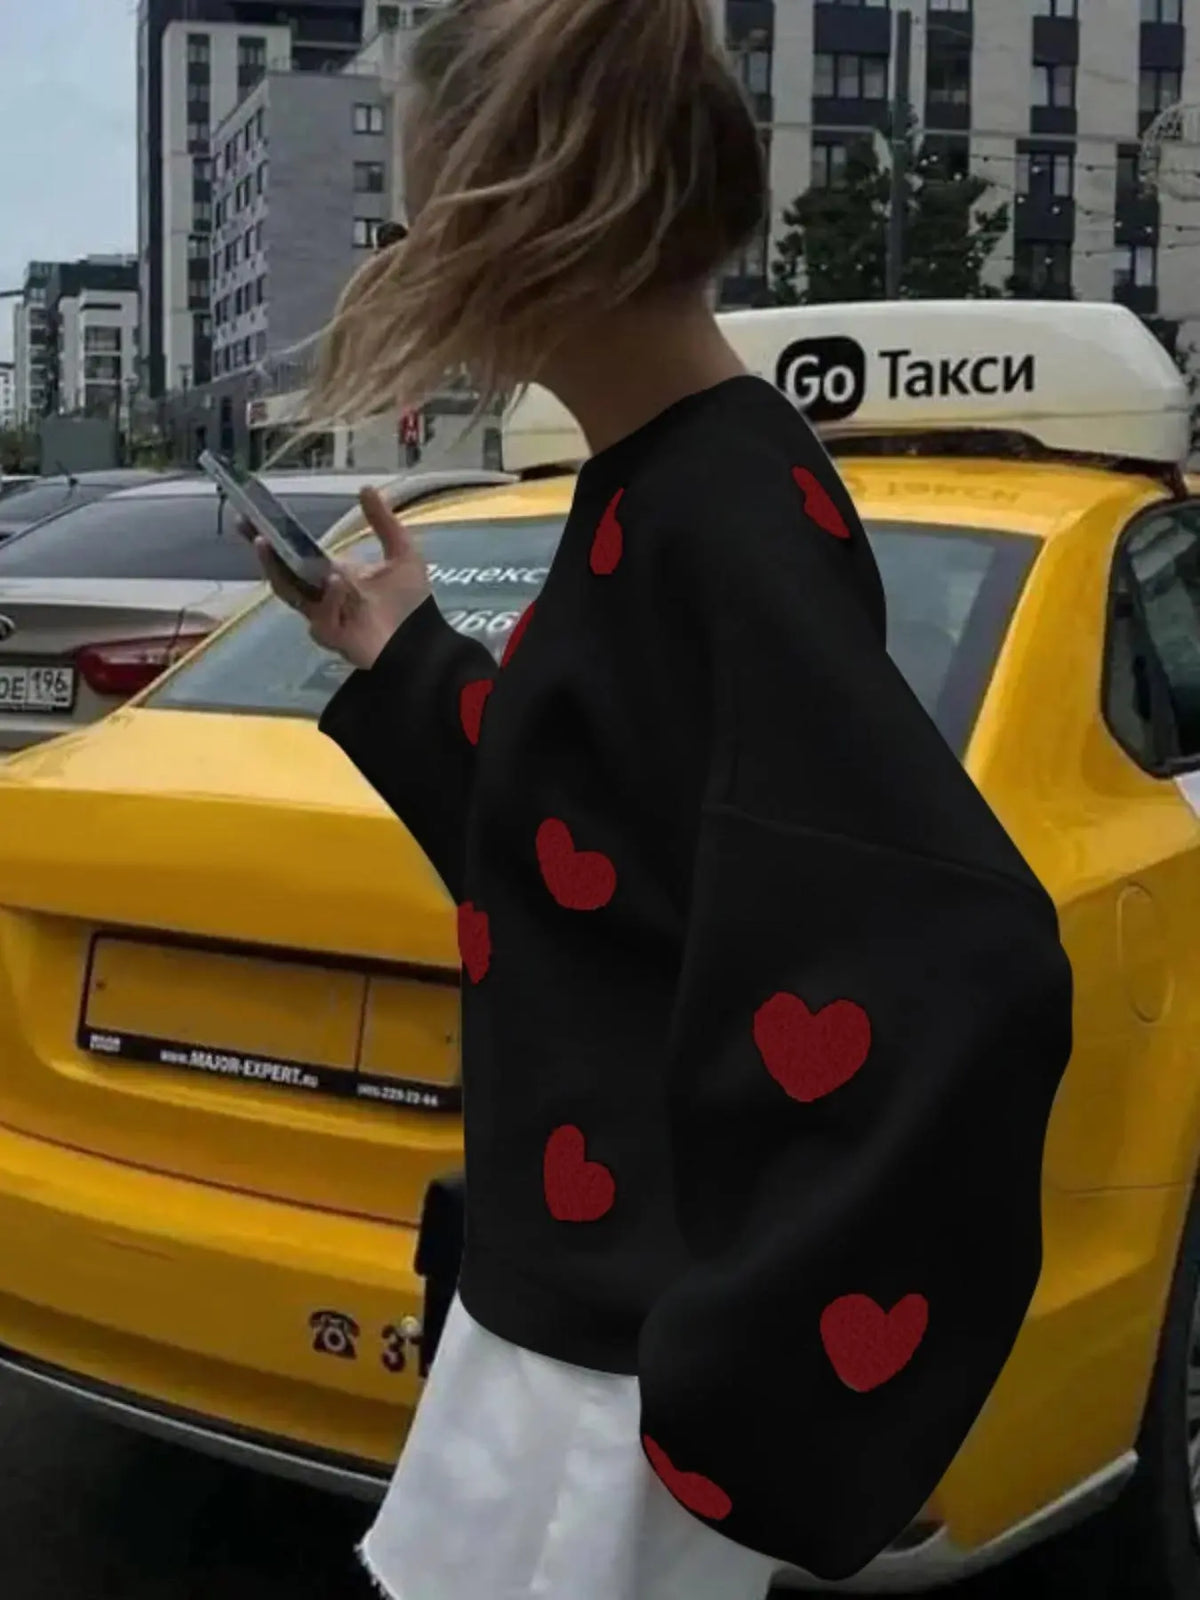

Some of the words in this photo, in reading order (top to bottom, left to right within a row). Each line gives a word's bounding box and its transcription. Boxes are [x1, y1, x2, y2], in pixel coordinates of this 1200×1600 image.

[785, 354, 856, 407] Go
[878, 349, 1036, 400] Такси
[31, 670, 68, 694] 196
